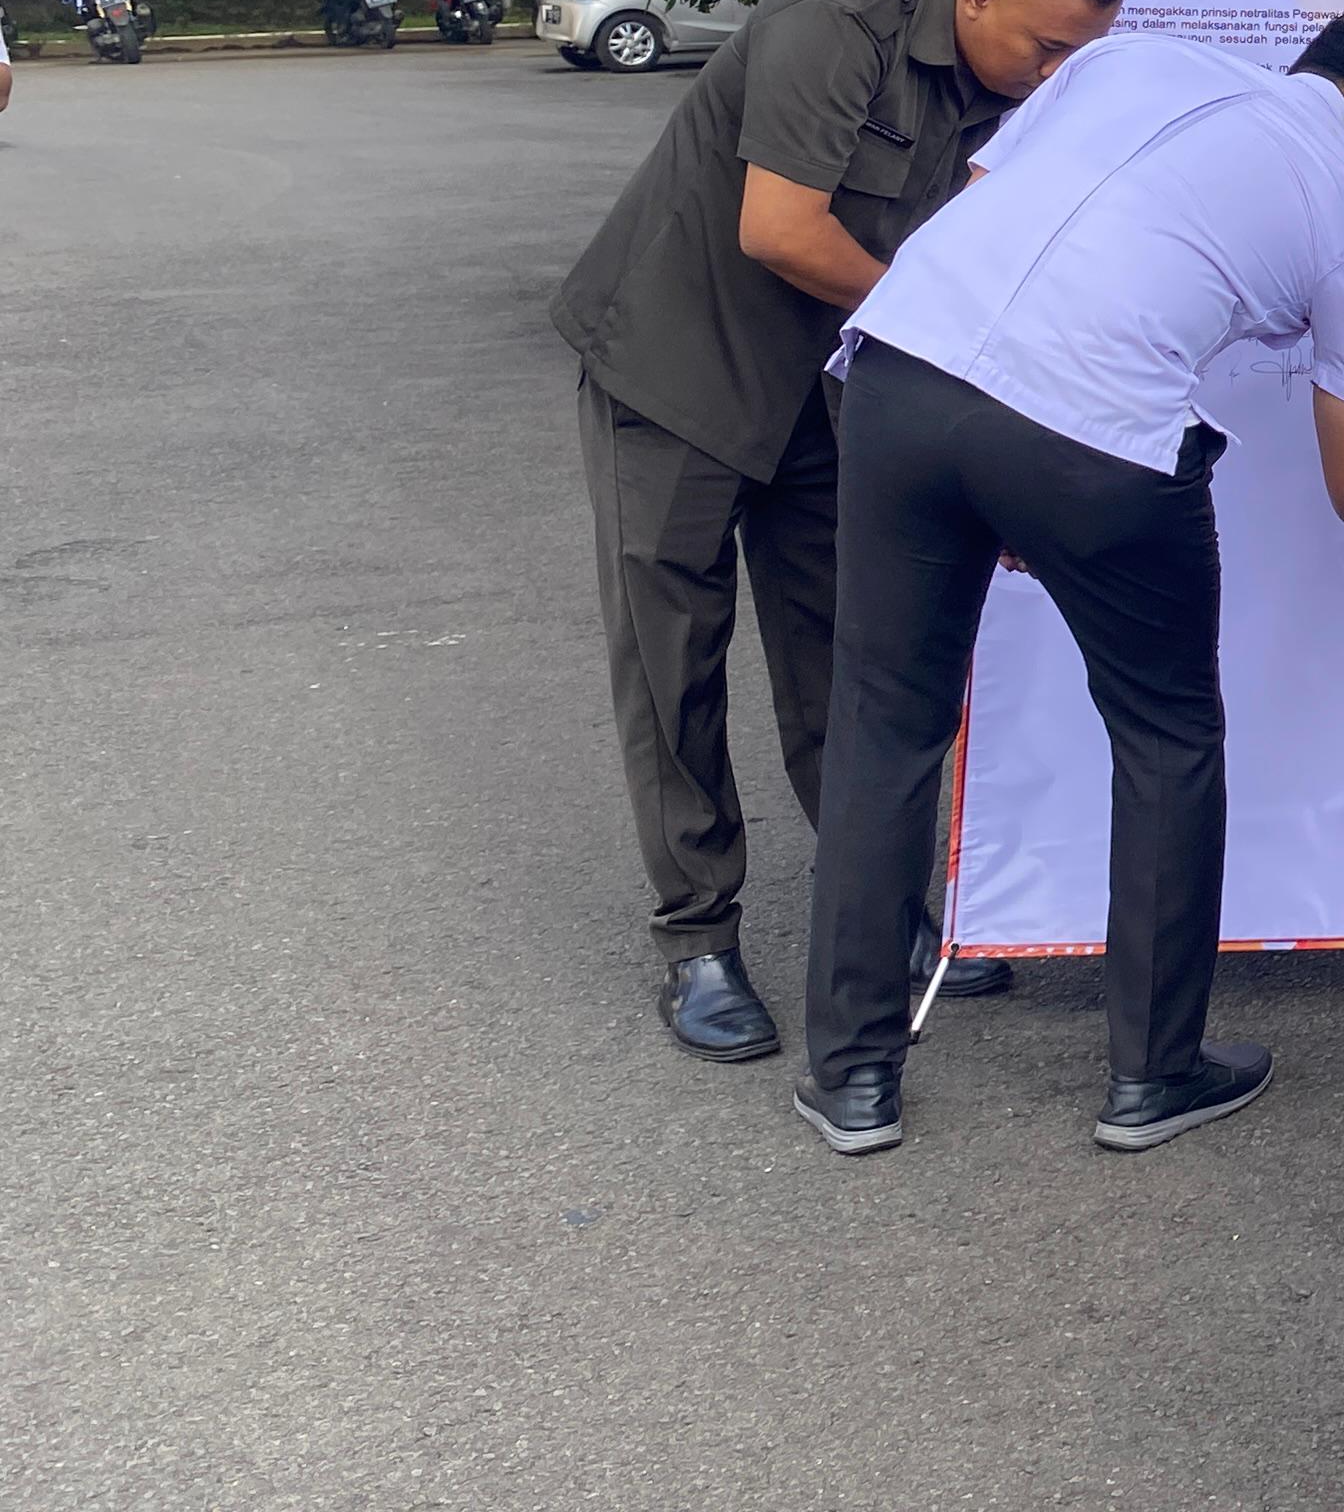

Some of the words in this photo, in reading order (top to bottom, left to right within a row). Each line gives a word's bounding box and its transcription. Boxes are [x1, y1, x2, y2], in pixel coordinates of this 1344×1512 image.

[1128, 6, 1199, 18] menegakkan
[1201, 8, 1238, 20] prinsip
[1240, 8, 1290, 19] netralitas
[1142, 18, 1176, 29] dalam
[1181, 19, 1261, 31] melaksanakan
[1264, 21, 1298, 33] fungsi
[1219, 34, 1268, 44] sesudah
